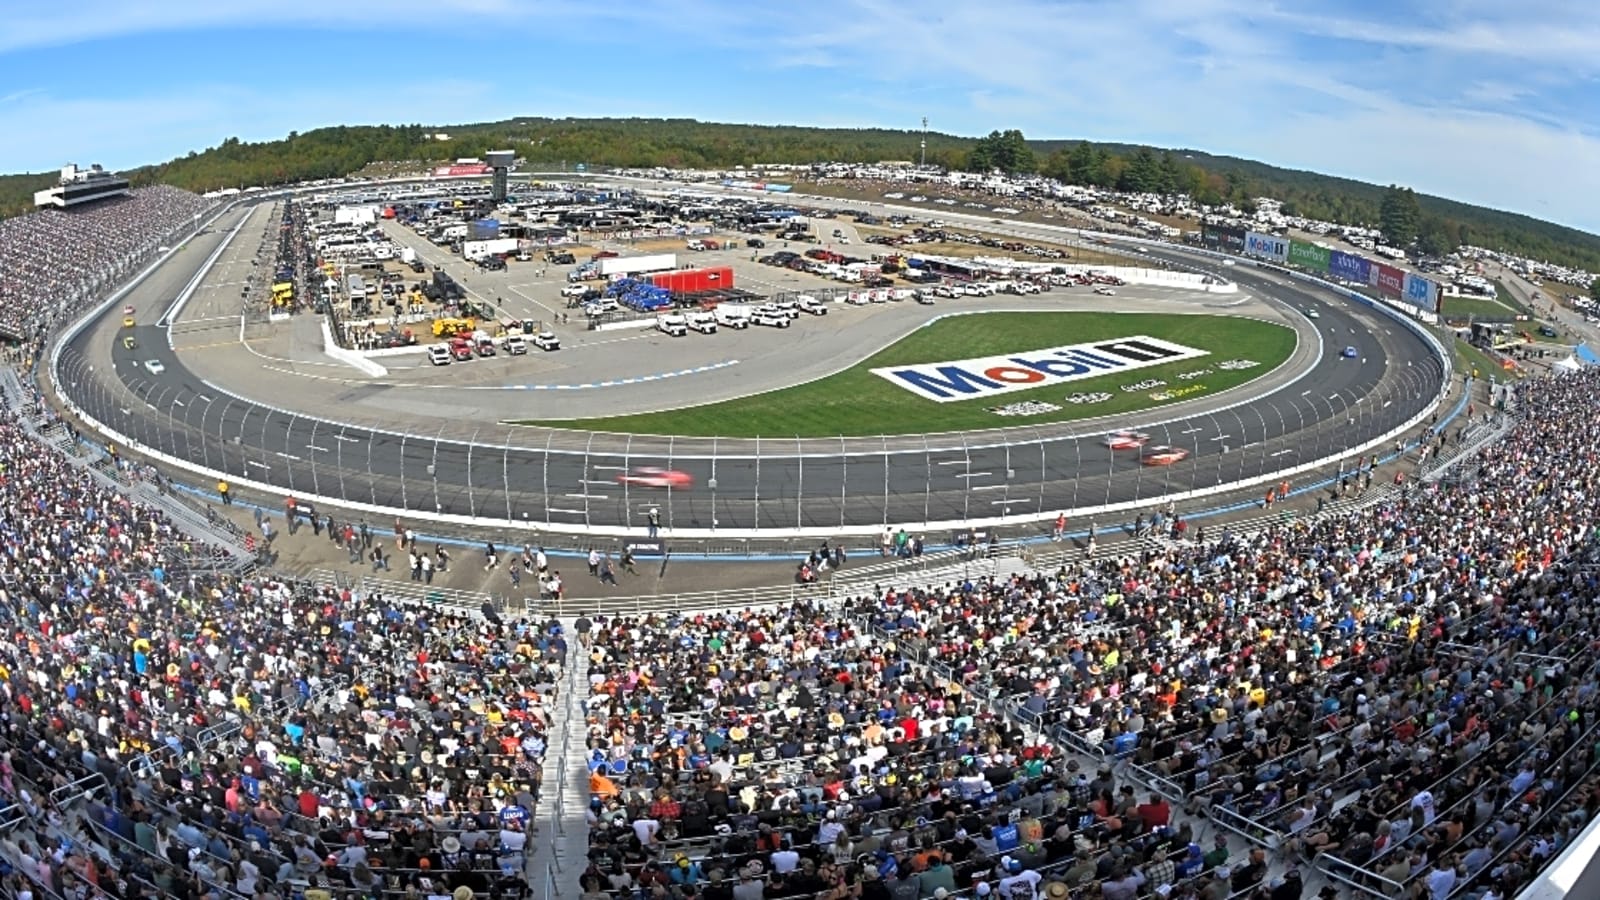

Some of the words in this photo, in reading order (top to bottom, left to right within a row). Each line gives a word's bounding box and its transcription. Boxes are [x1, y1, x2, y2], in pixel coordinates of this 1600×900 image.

[1249, 237, 1274, 254] Mobil
[1292, 244, 1325, 262] EchoPark
[892, 349, 1126, 398] Mobil
[1094, 340, 1185, 362] 1
